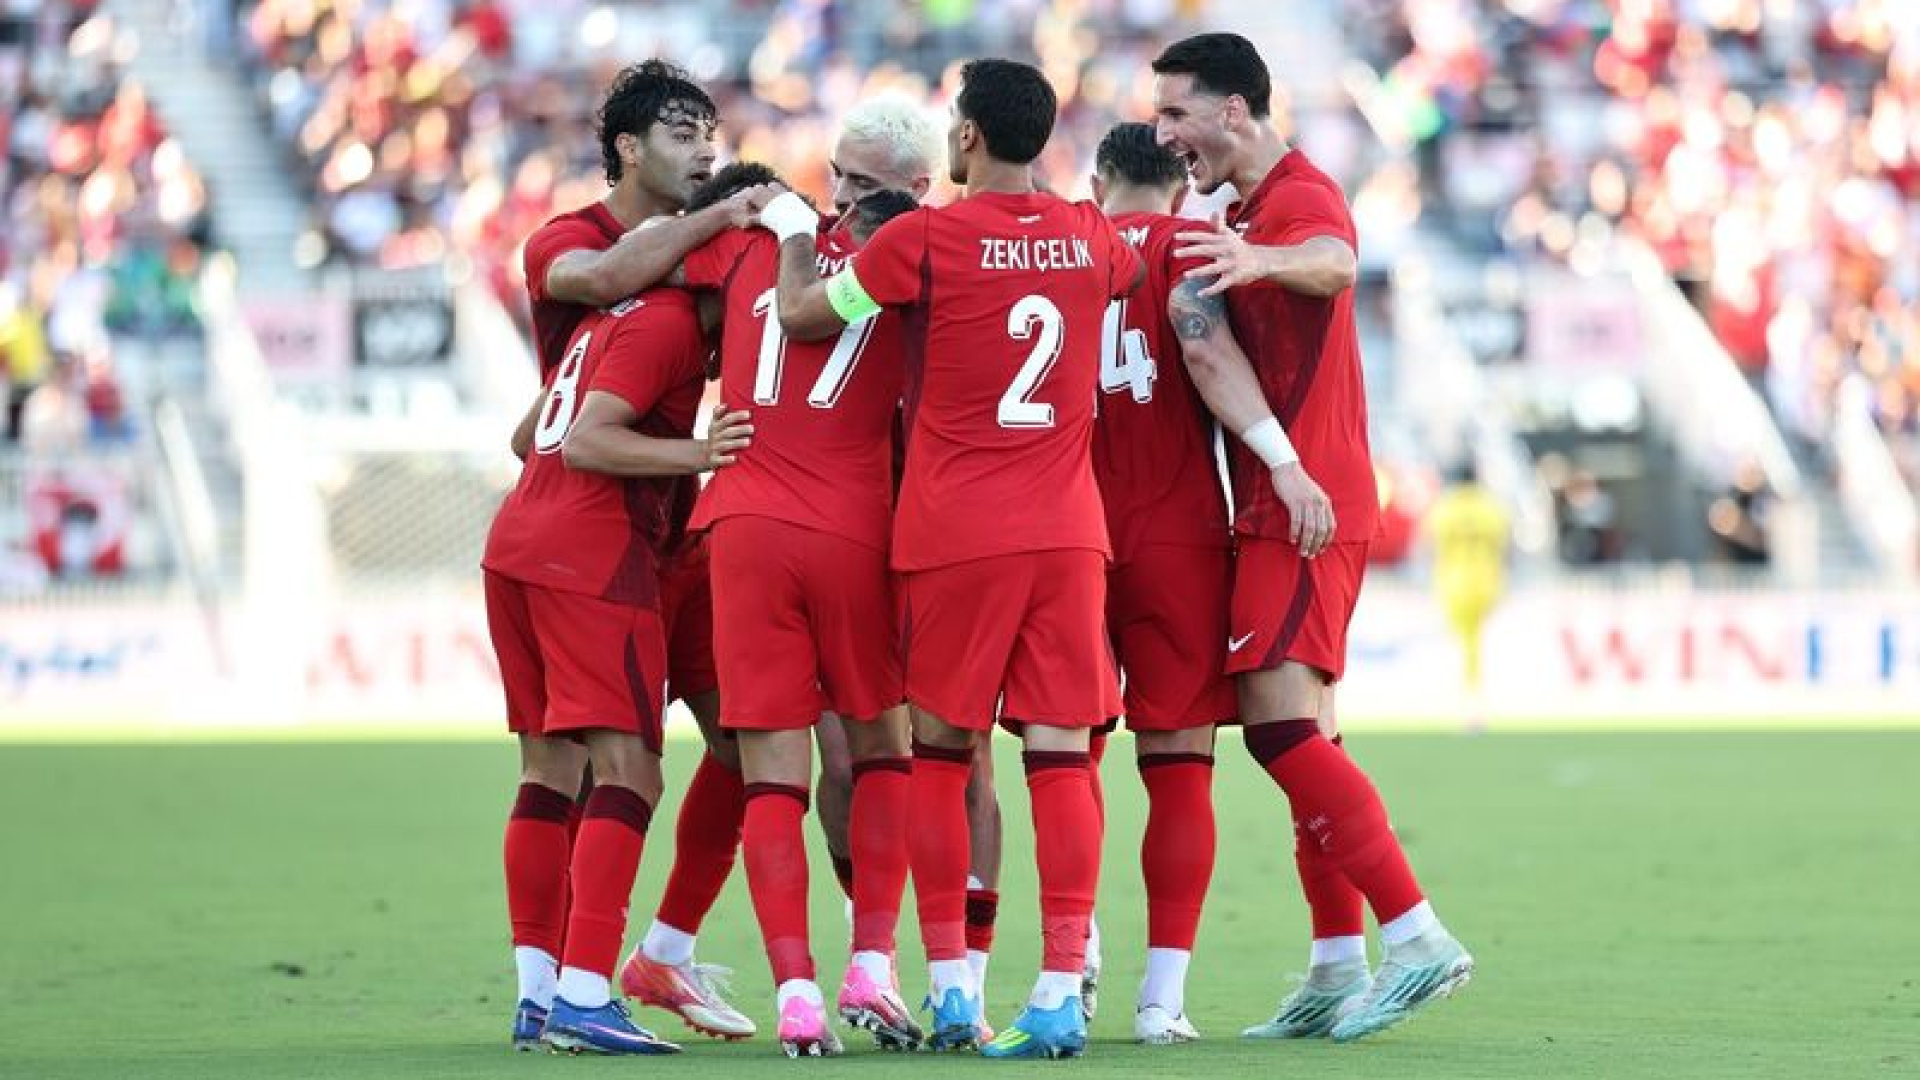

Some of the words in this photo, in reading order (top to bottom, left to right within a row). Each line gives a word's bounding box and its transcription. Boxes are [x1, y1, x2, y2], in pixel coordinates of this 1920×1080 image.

[980, 234, 1031, 270] ZEKİ
[1033, 233, 1096, 273] ÇELİK
[535, 330, 592, 455] 8
[751, 286, 880, 409] 17
[998, 294, 1064, 428] 2
